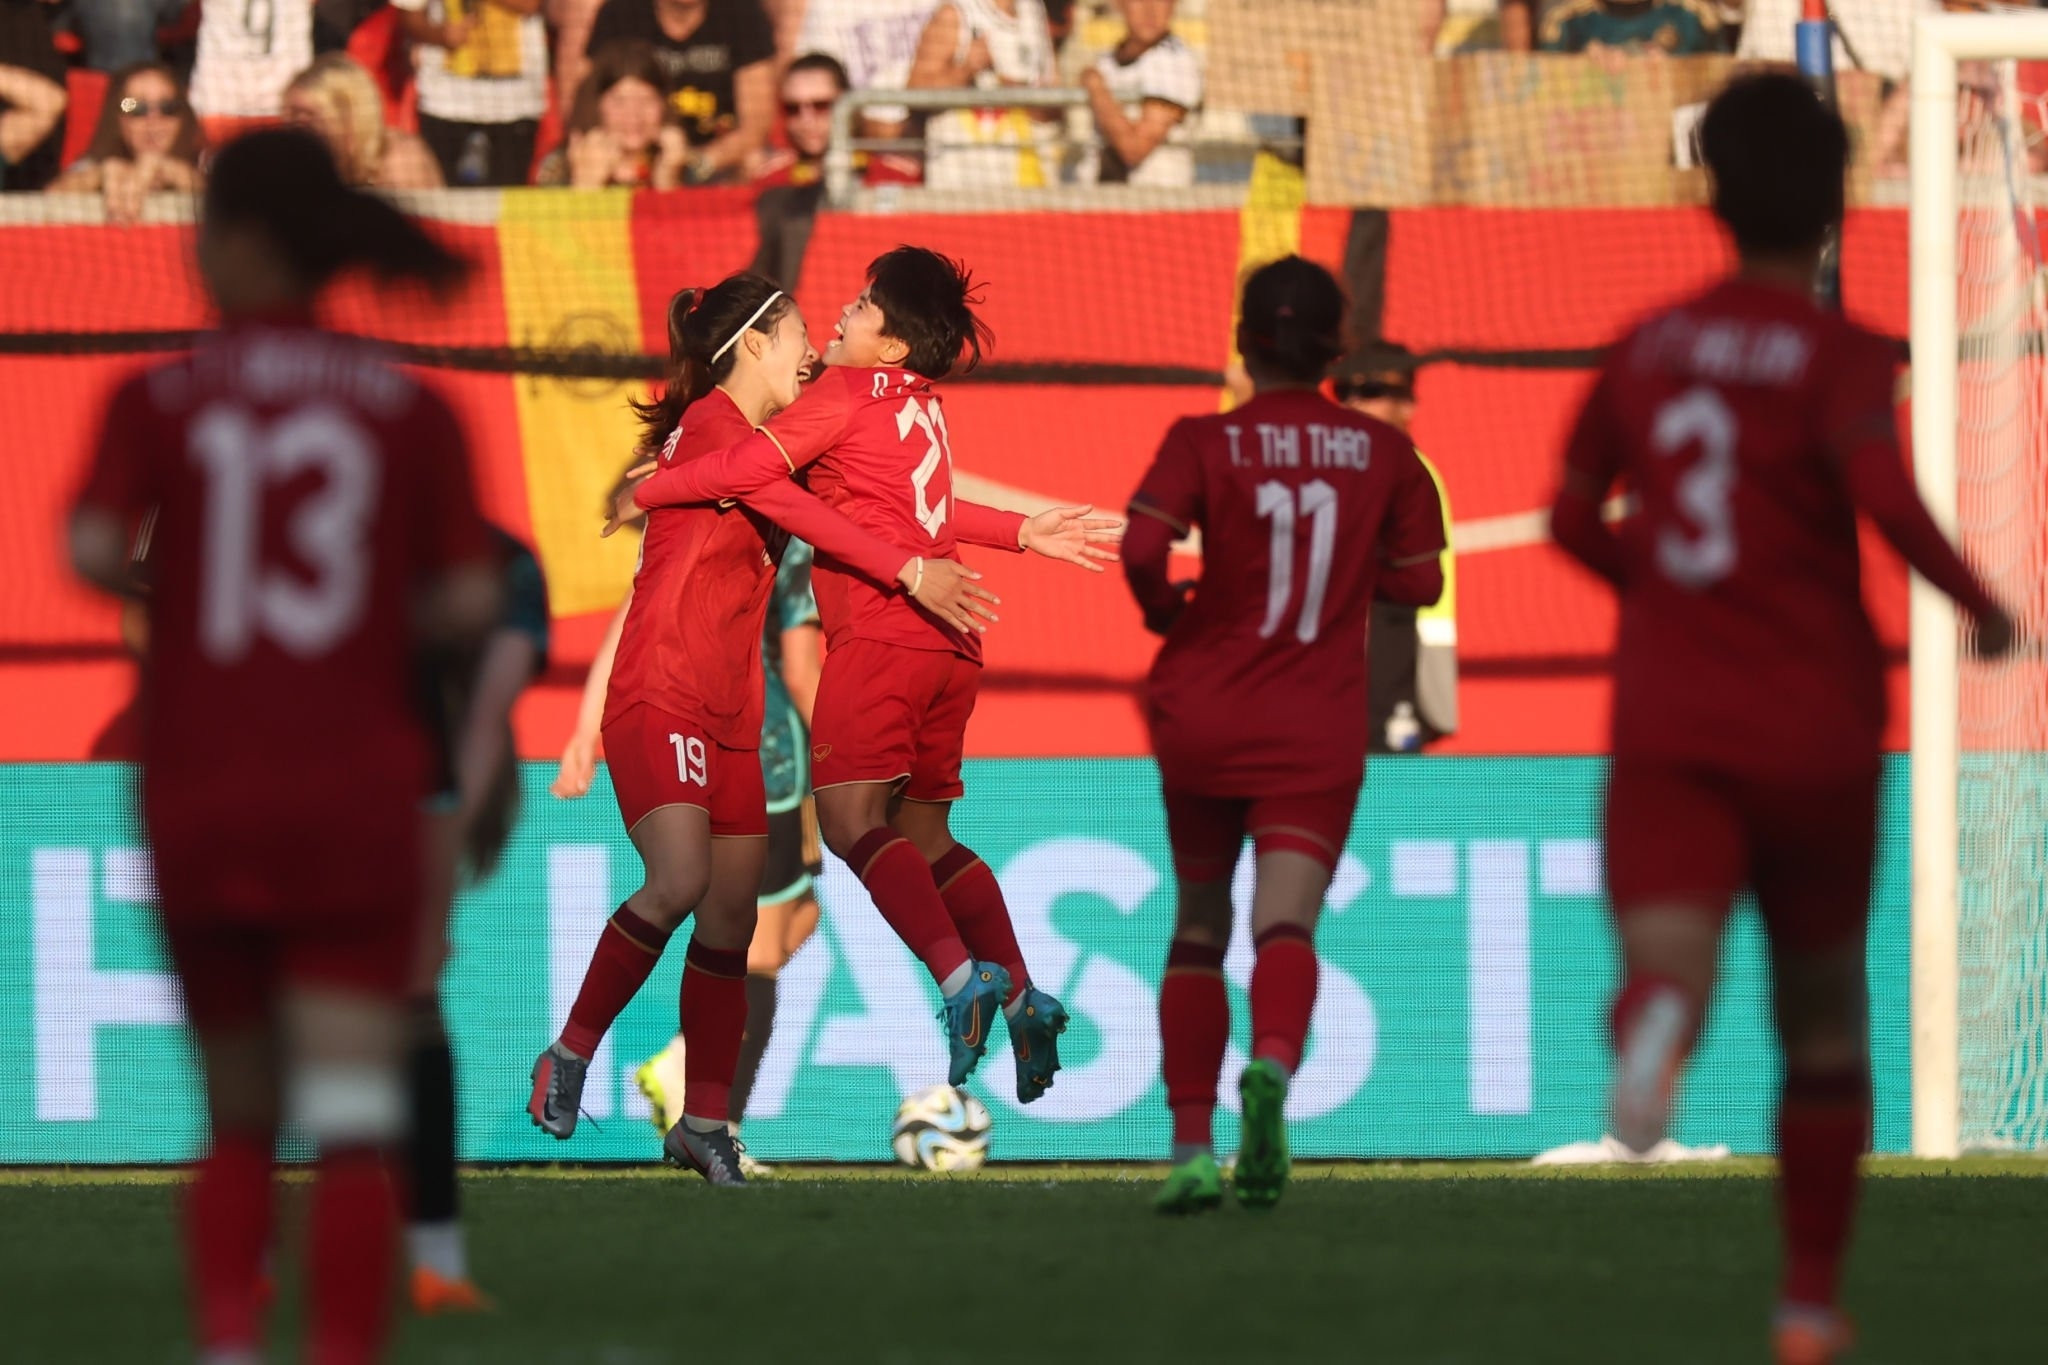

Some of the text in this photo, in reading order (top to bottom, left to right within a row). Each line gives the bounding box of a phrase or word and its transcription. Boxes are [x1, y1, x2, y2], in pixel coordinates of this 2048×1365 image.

[1256, 424, 1299, 468] THI
[1653, 390, 1736, 587] 3
[189, 403, 380, 658] 13
[1256, 479, 1337, 642] 11
[669, 732, 707, 787] 19
